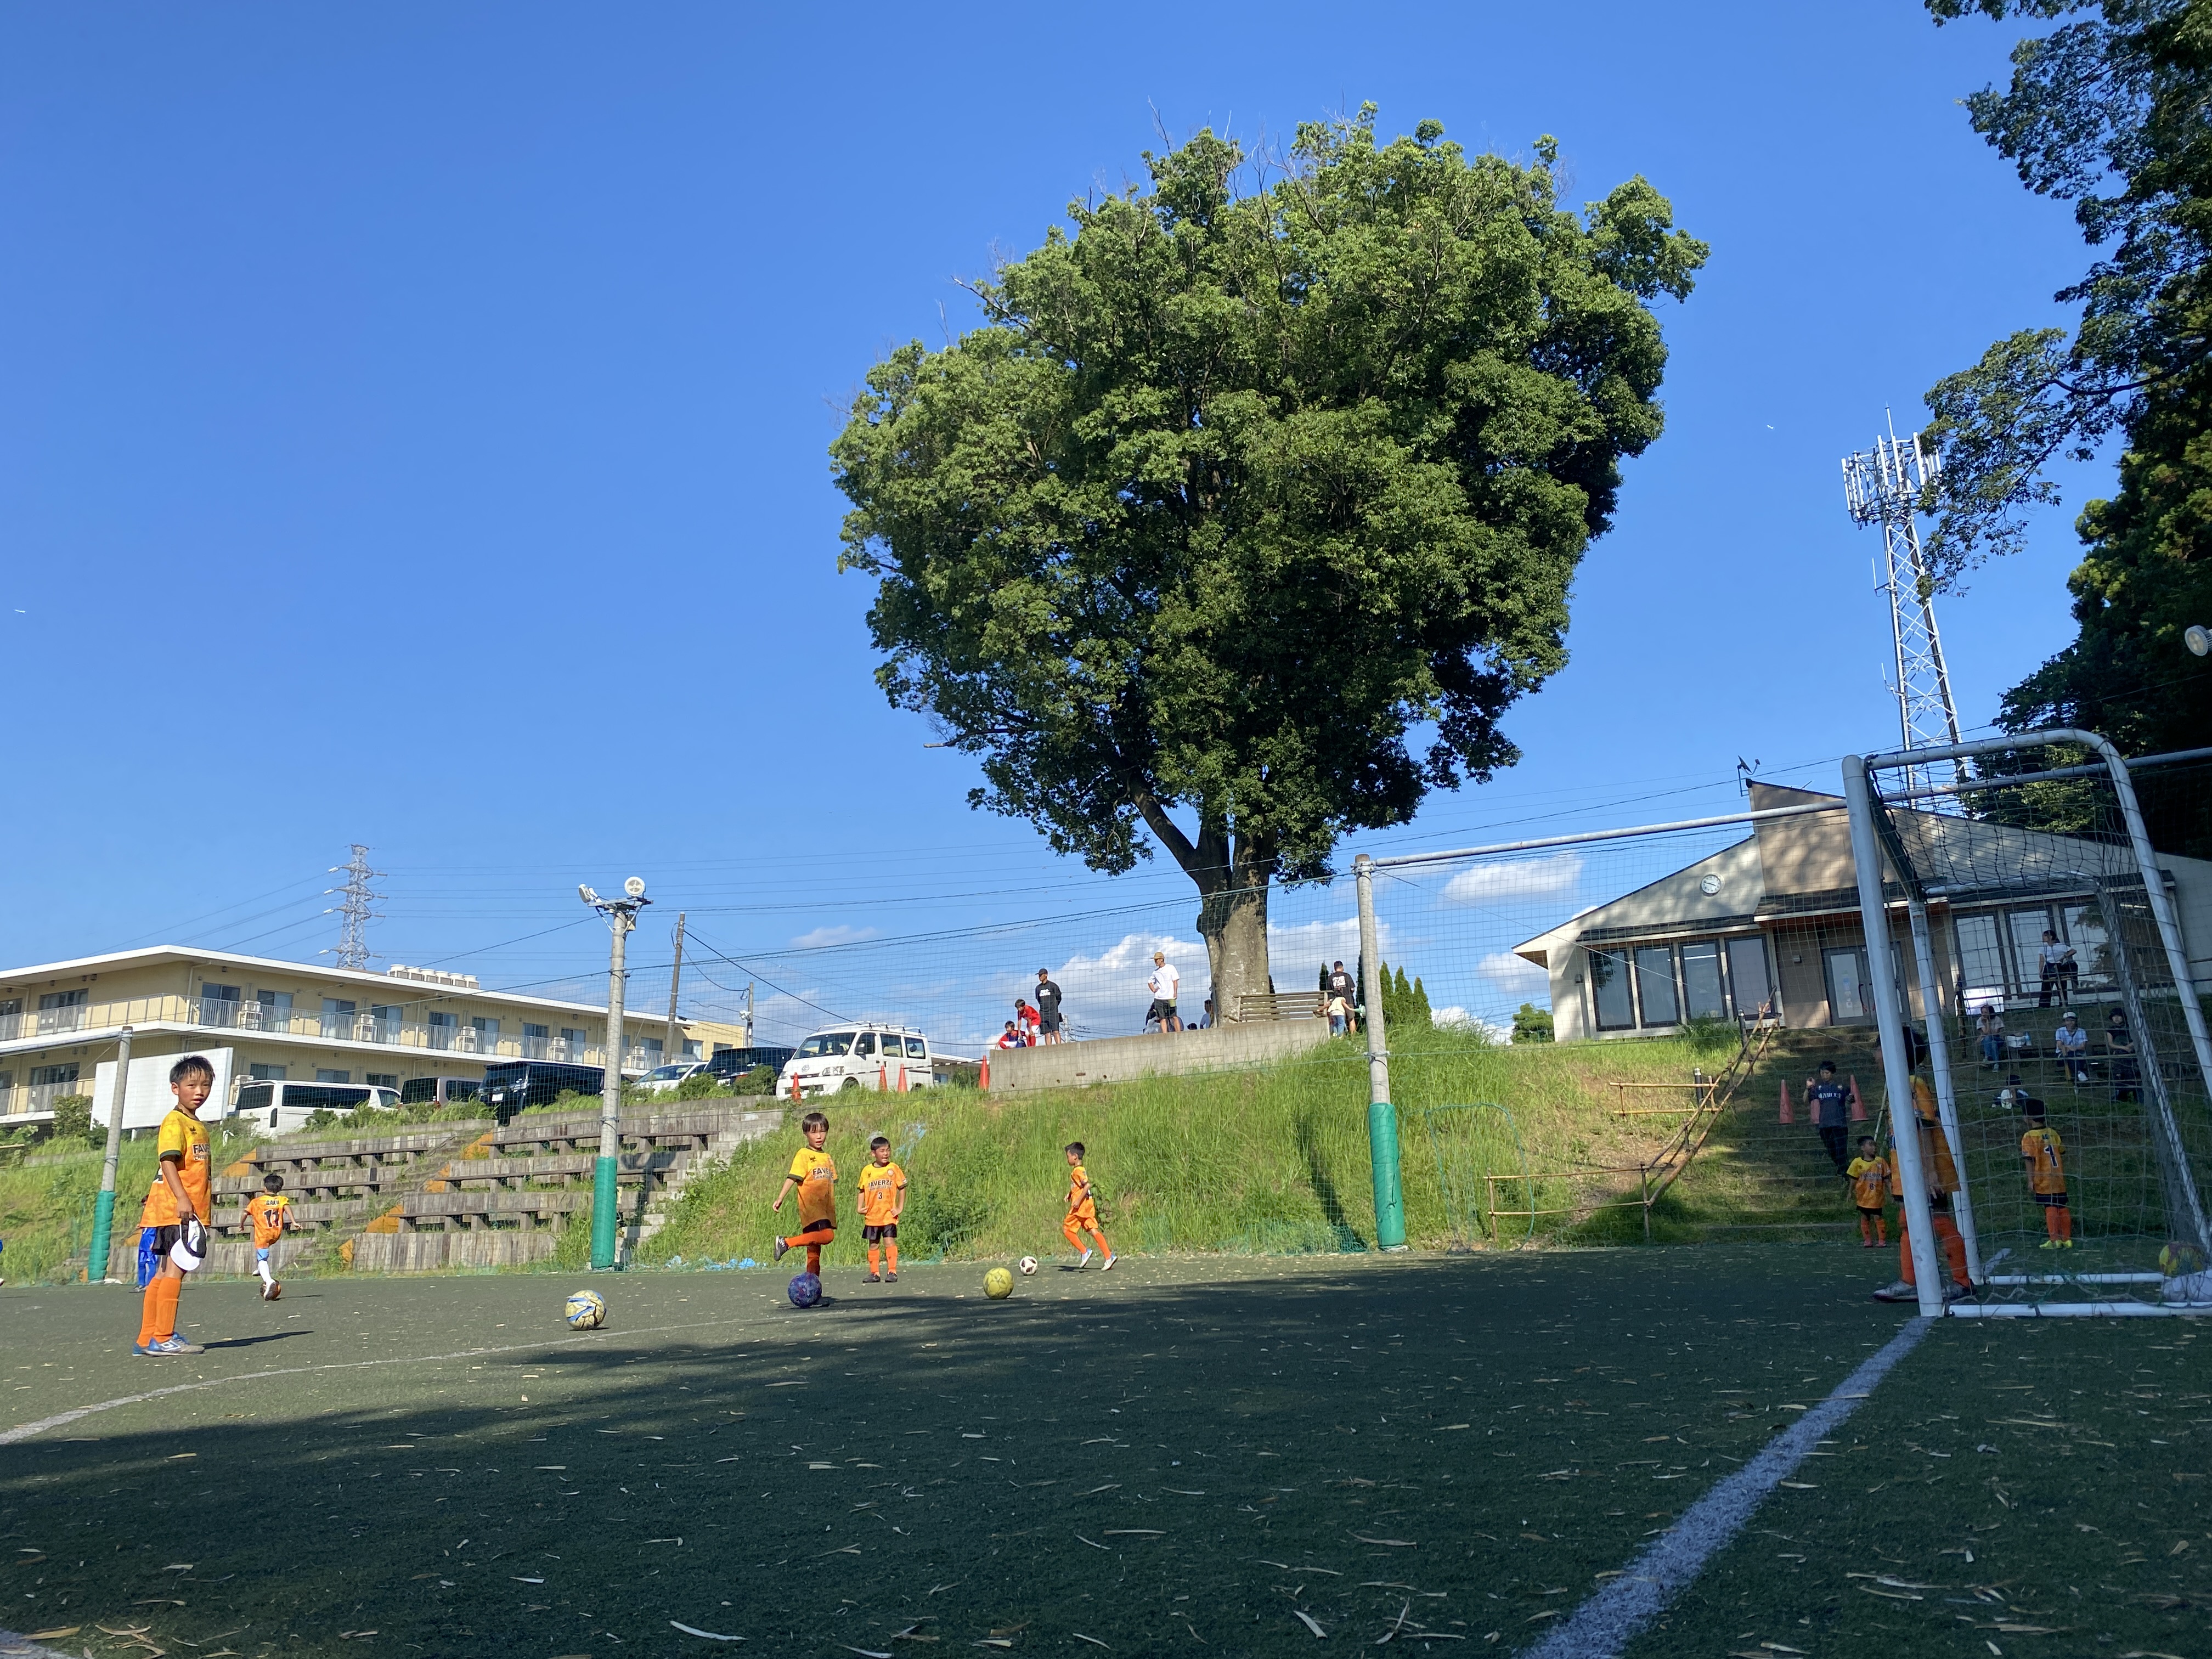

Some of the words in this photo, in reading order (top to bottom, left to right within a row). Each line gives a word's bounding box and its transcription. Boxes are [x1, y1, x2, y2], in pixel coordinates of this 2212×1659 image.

[2045, 1144, 2057, 1167] 1
[878, 1192, 882, 1200] 3
[263, 1209, 279, 1227] 11
